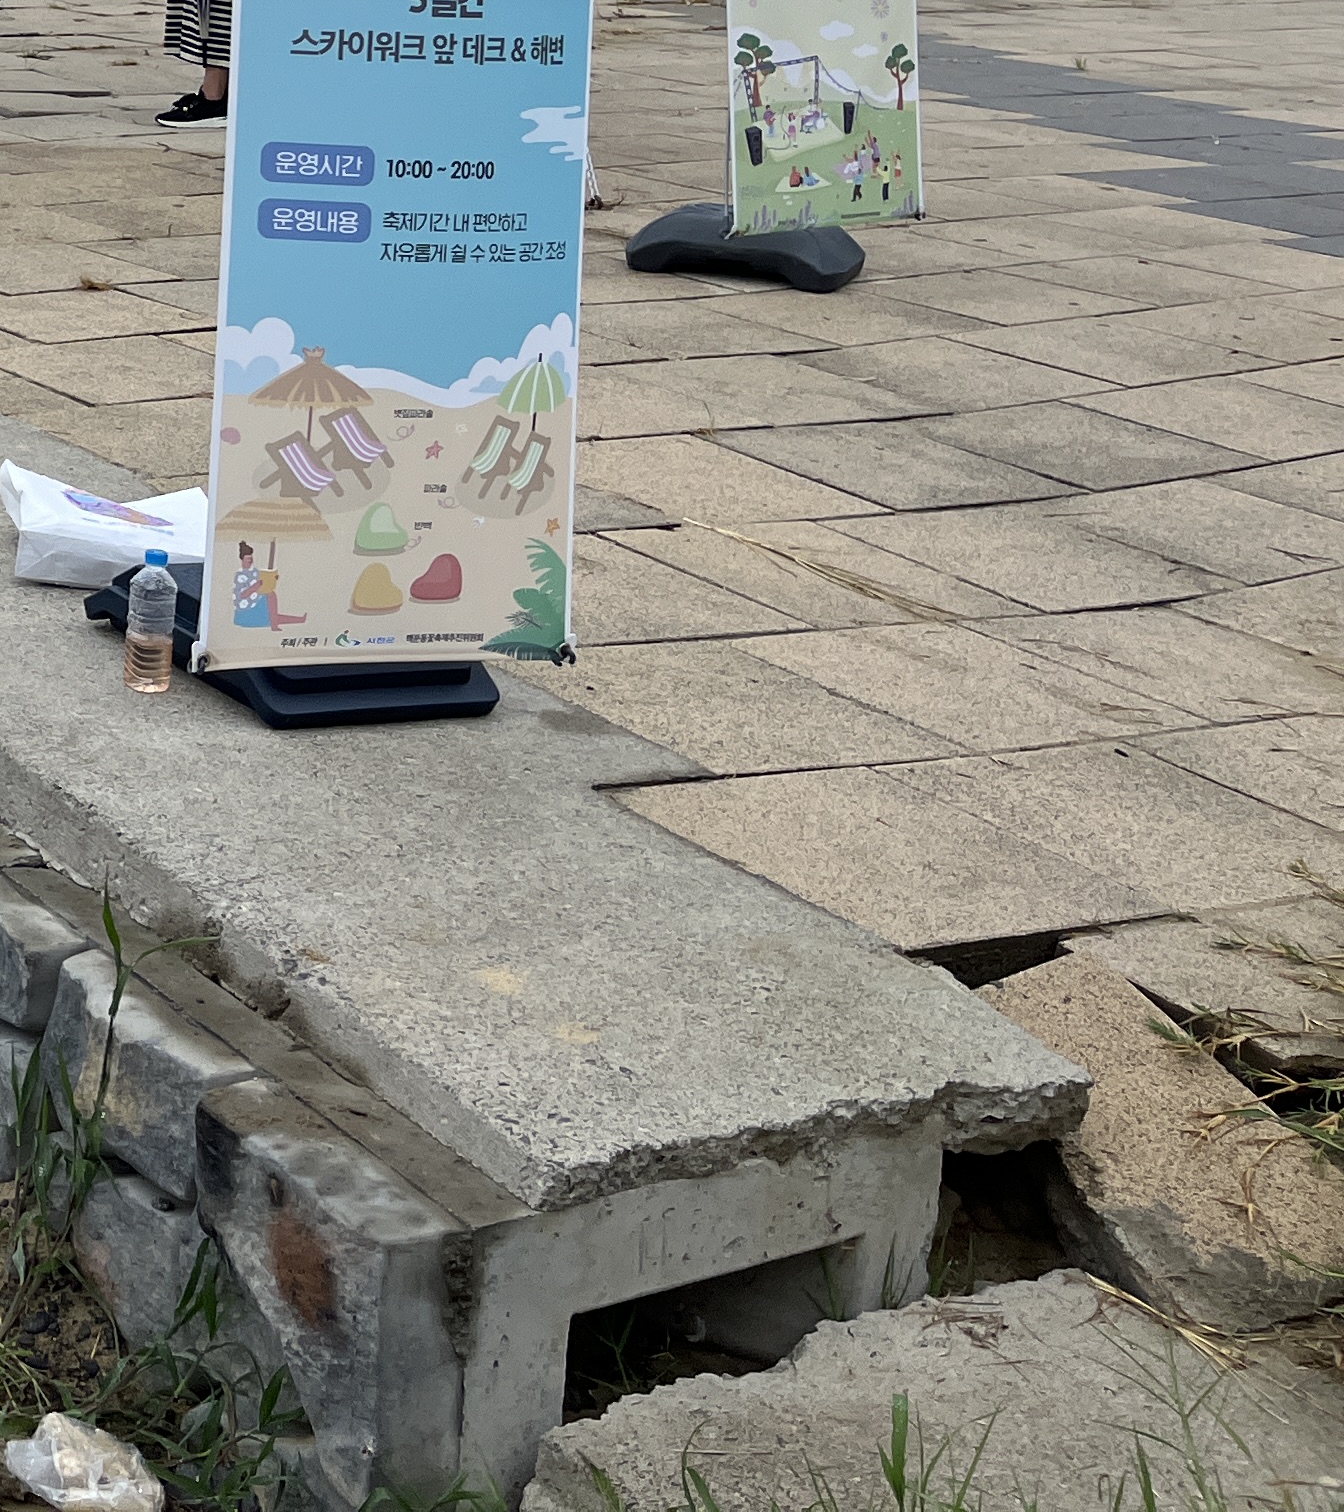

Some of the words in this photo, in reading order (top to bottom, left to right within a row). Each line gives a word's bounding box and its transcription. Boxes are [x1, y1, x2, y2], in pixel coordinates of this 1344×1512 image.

[290, 29, 426, 64] 스카이워크
[433, 33, 458, 65] 앞
[462, 32, 506, 65] 데크
[511, 38, 526, 63] &
[530, 34, 565, 66] 해변
[274, 151, 363, 178] 운영시간
[386, 159, 433, 179] 10:00
[450, 160, 495, 180] 20:00
[271, 206, 359, 234] 운영내용
[382, 211, 451, 233] 축제기간
[453, 212, 470, 233] 내
[472, 212, 528, 233] 편안하고
[379, 242, 448, 264] 자유롭게
[450, 242, 468, 264] 쉴
[469, 243, 486, 264] 수
[488, 242, 516, 263] 있는
[518, 242, 544, 262] 공간
[544, 240, 567, 261] 조성
